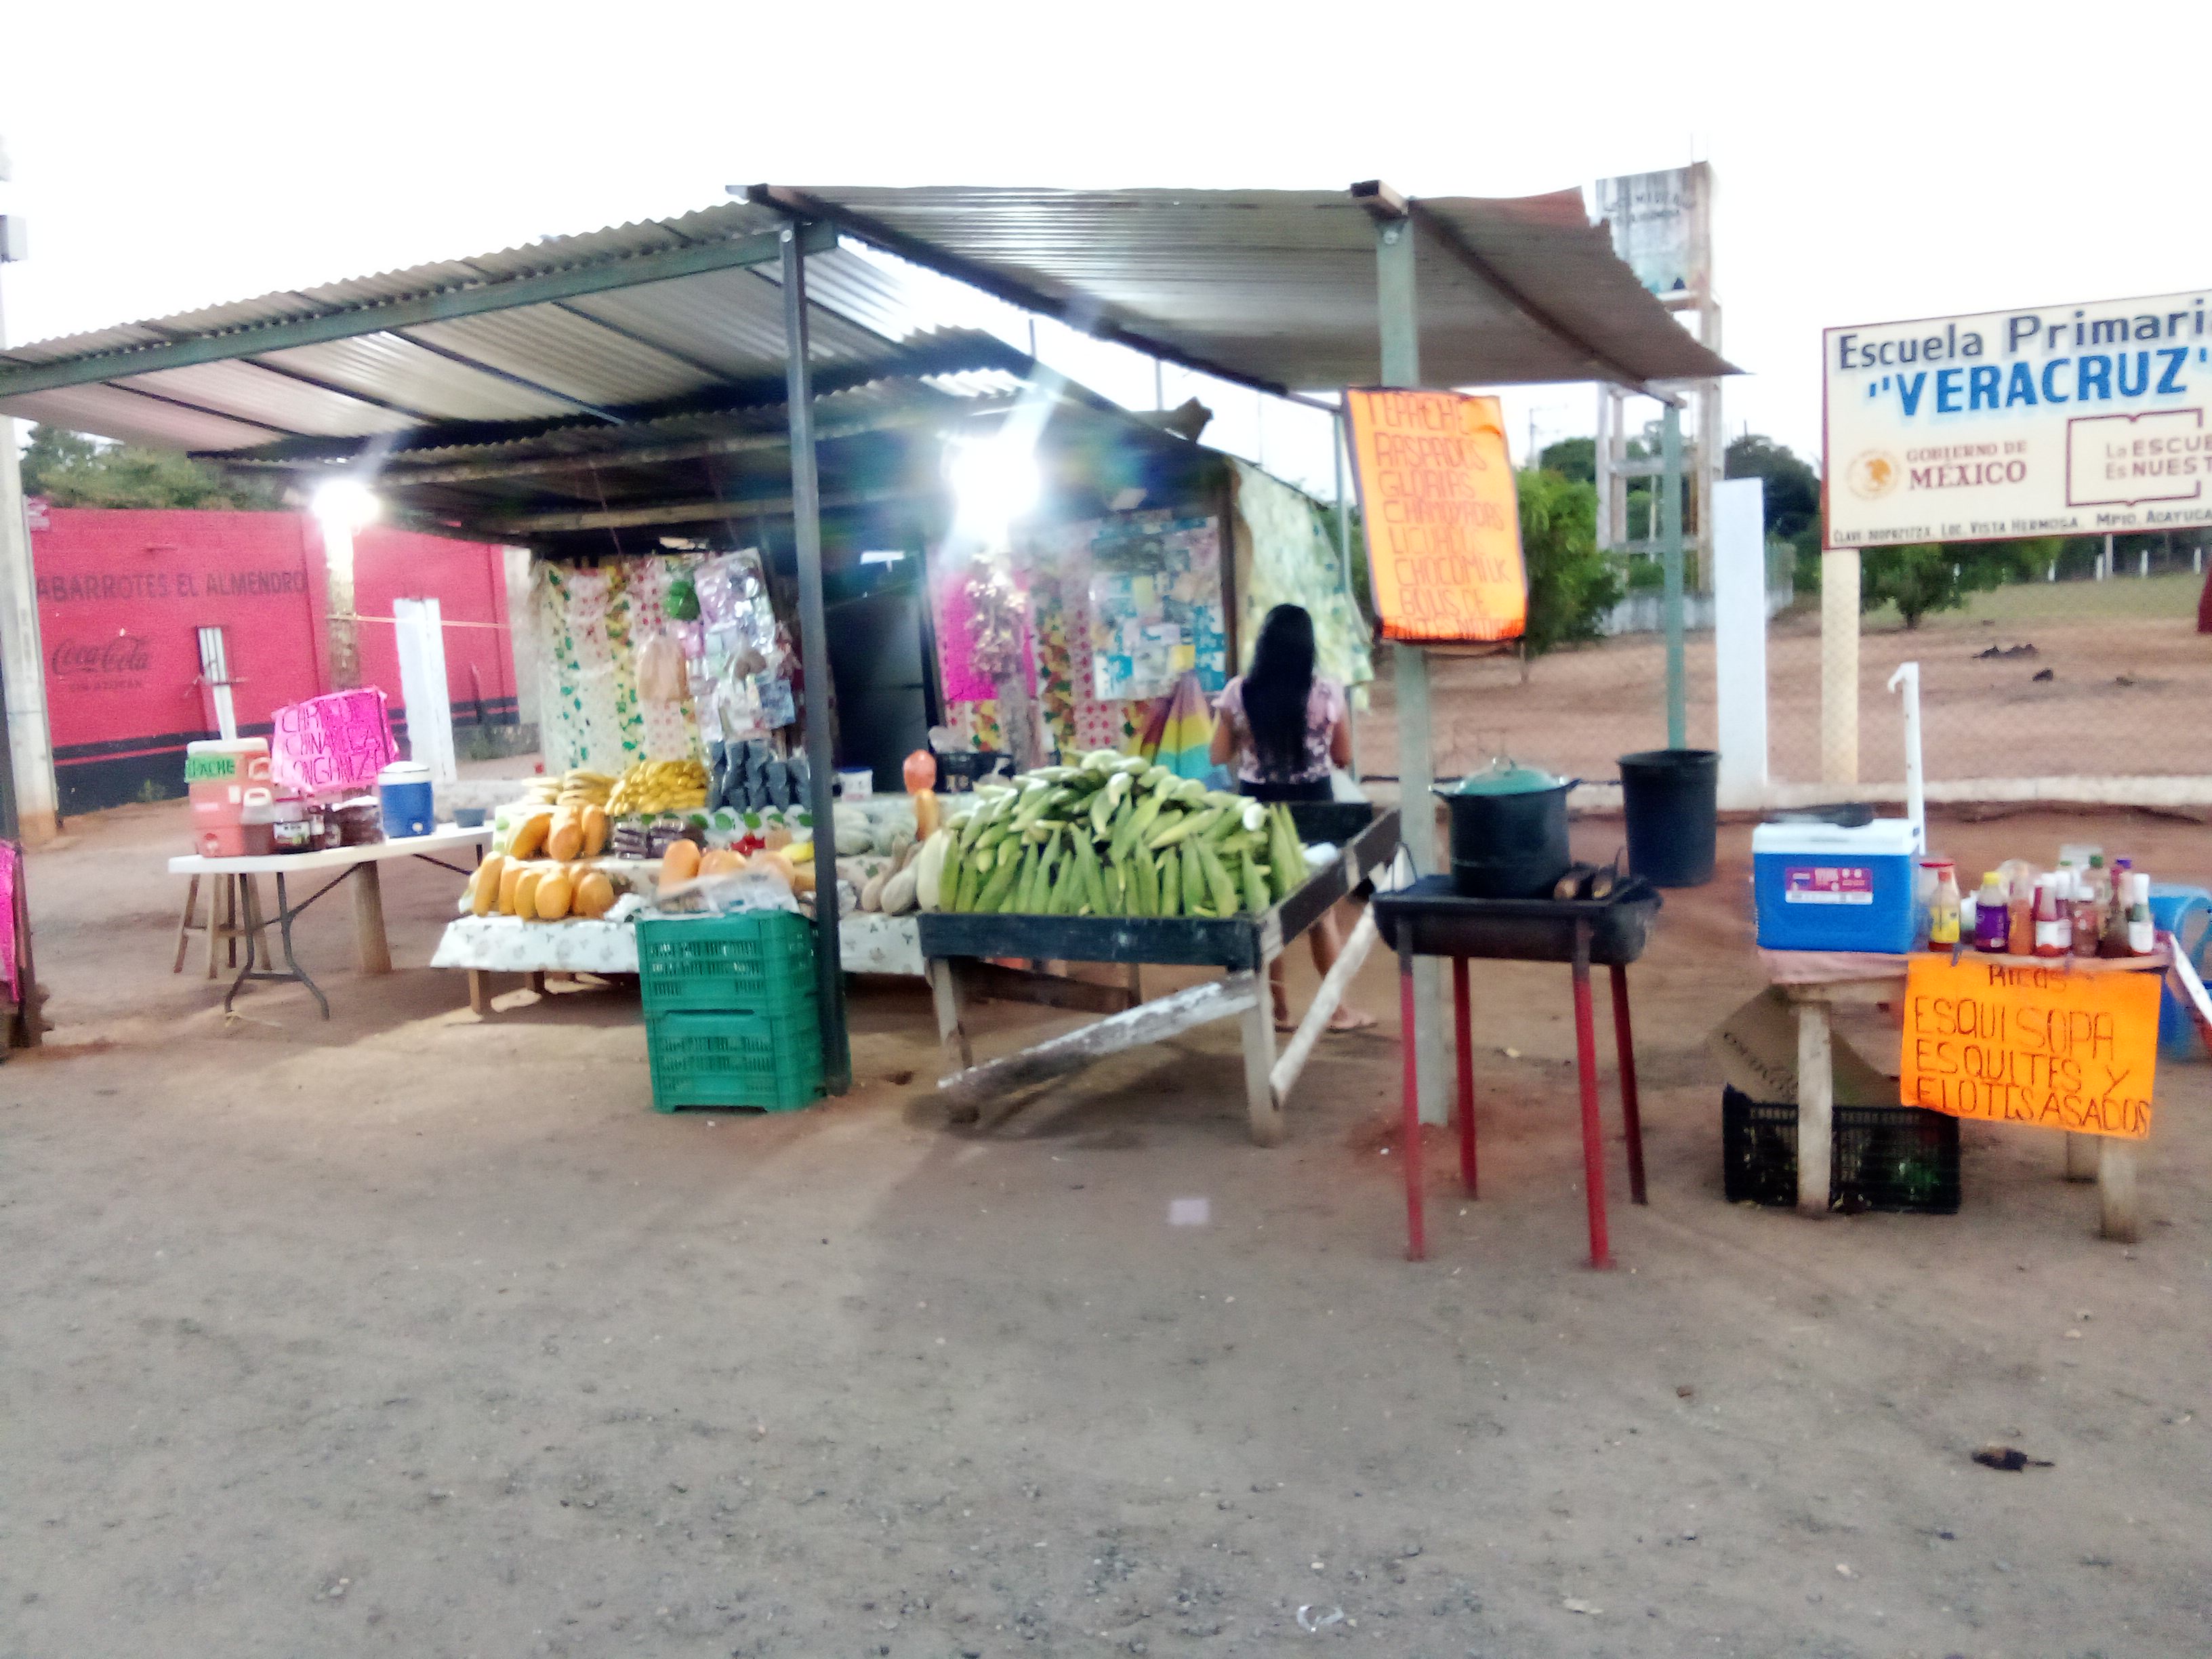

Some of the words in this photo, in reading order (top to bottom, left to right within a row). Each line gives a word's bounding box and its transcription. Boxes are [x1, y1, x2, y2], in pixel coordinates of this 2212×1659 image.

[1840, 323, 1984, 370] Escuela
[2007, 298, 2212, 352] Primari
[1906, 443, 1998, 463] GOBIERNO
[2003, 440, 2028, 455] DE
[36, 573, 169, 602] ABARROTES
[176, 572, 199, 597] EL
[205, 569, 308, 596] ALMENDRO
[1394, 554, 1511, 586] CHOCOMILK
[1988, 964, 2067, 994] RICOS
[1916, 1038, 2083, 1094] ESQUITES
[2104, 1065, 2131, 1099] Y
